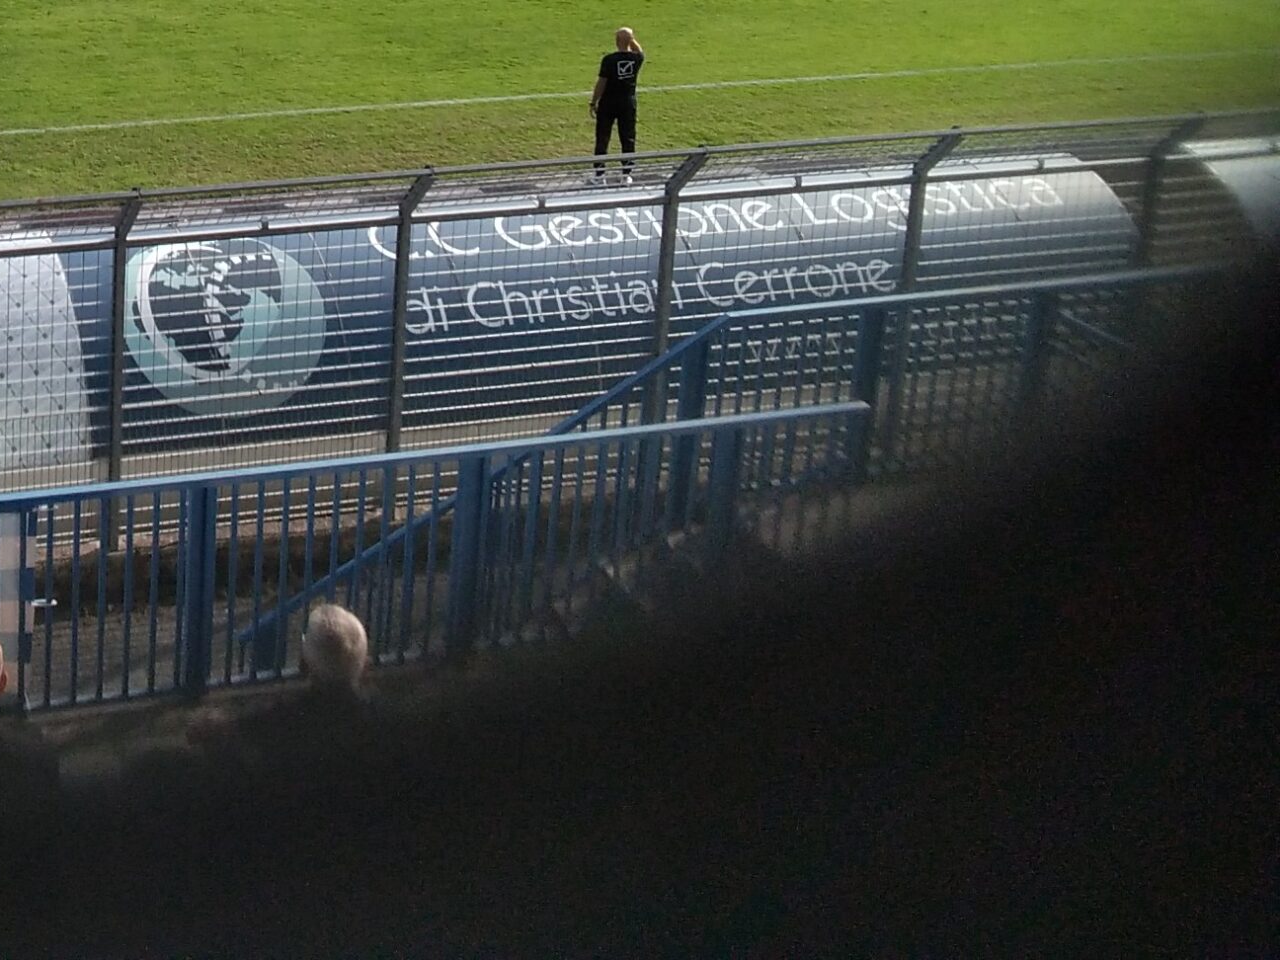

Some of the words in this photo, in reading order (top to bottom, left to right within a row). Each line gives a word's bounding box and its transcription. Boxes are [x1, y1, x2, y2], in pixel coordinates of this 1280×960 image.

[494, 198, 784, 251] Gestione
[405, 284, 451, 335] di
[698, 258, 897, 309] Cerrone
